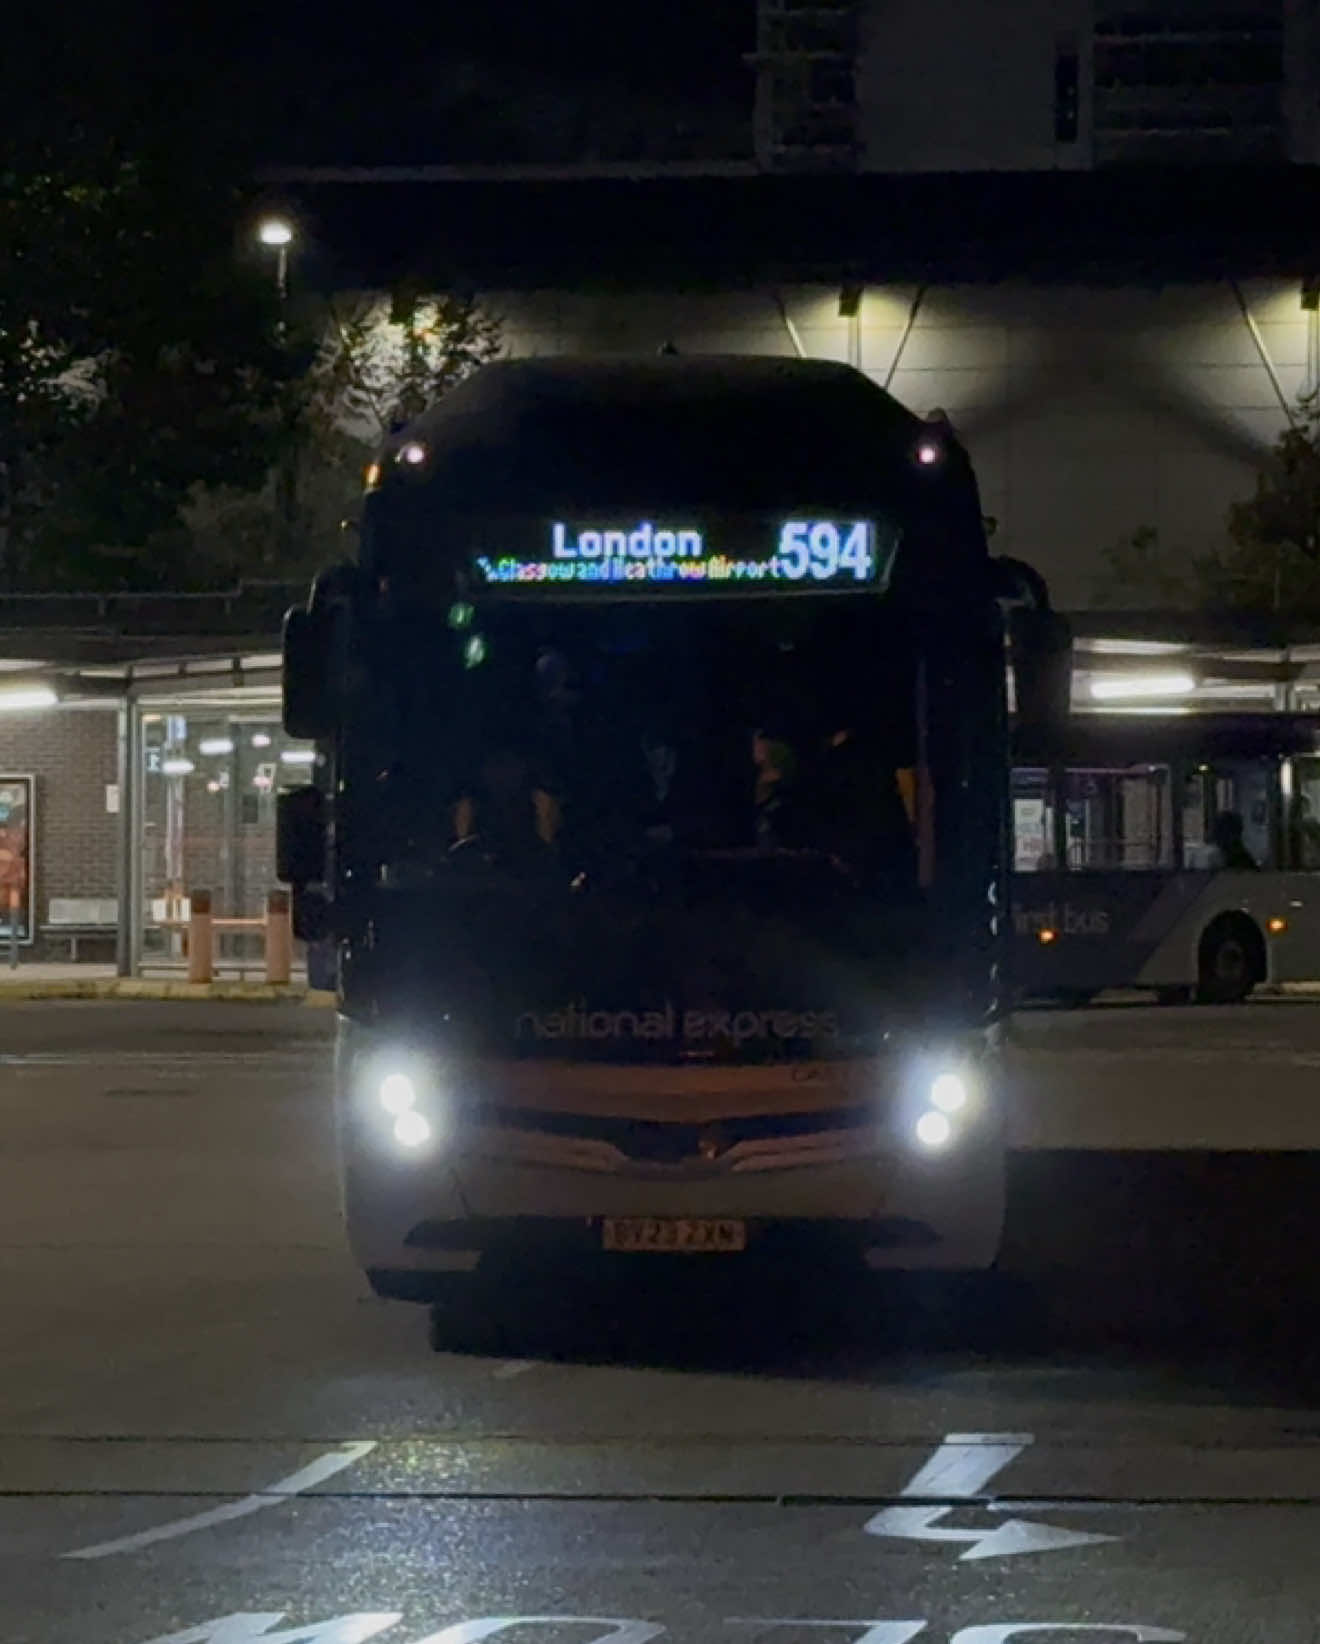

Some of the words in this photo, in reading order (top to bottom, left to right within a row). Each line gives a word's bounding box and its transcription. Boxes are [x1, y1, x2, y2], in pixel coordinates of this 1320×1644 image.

[552, 521, 703, 558] London
[779, 520, 873, 580] 594
[498, 558, 575, 581] Glasgow
[707, 555, 781, 580] Airport
[1063, 903, 1110, 934] bus
[516, 999, 674, 1040] national
[682, 1009, 841, 1048] express
